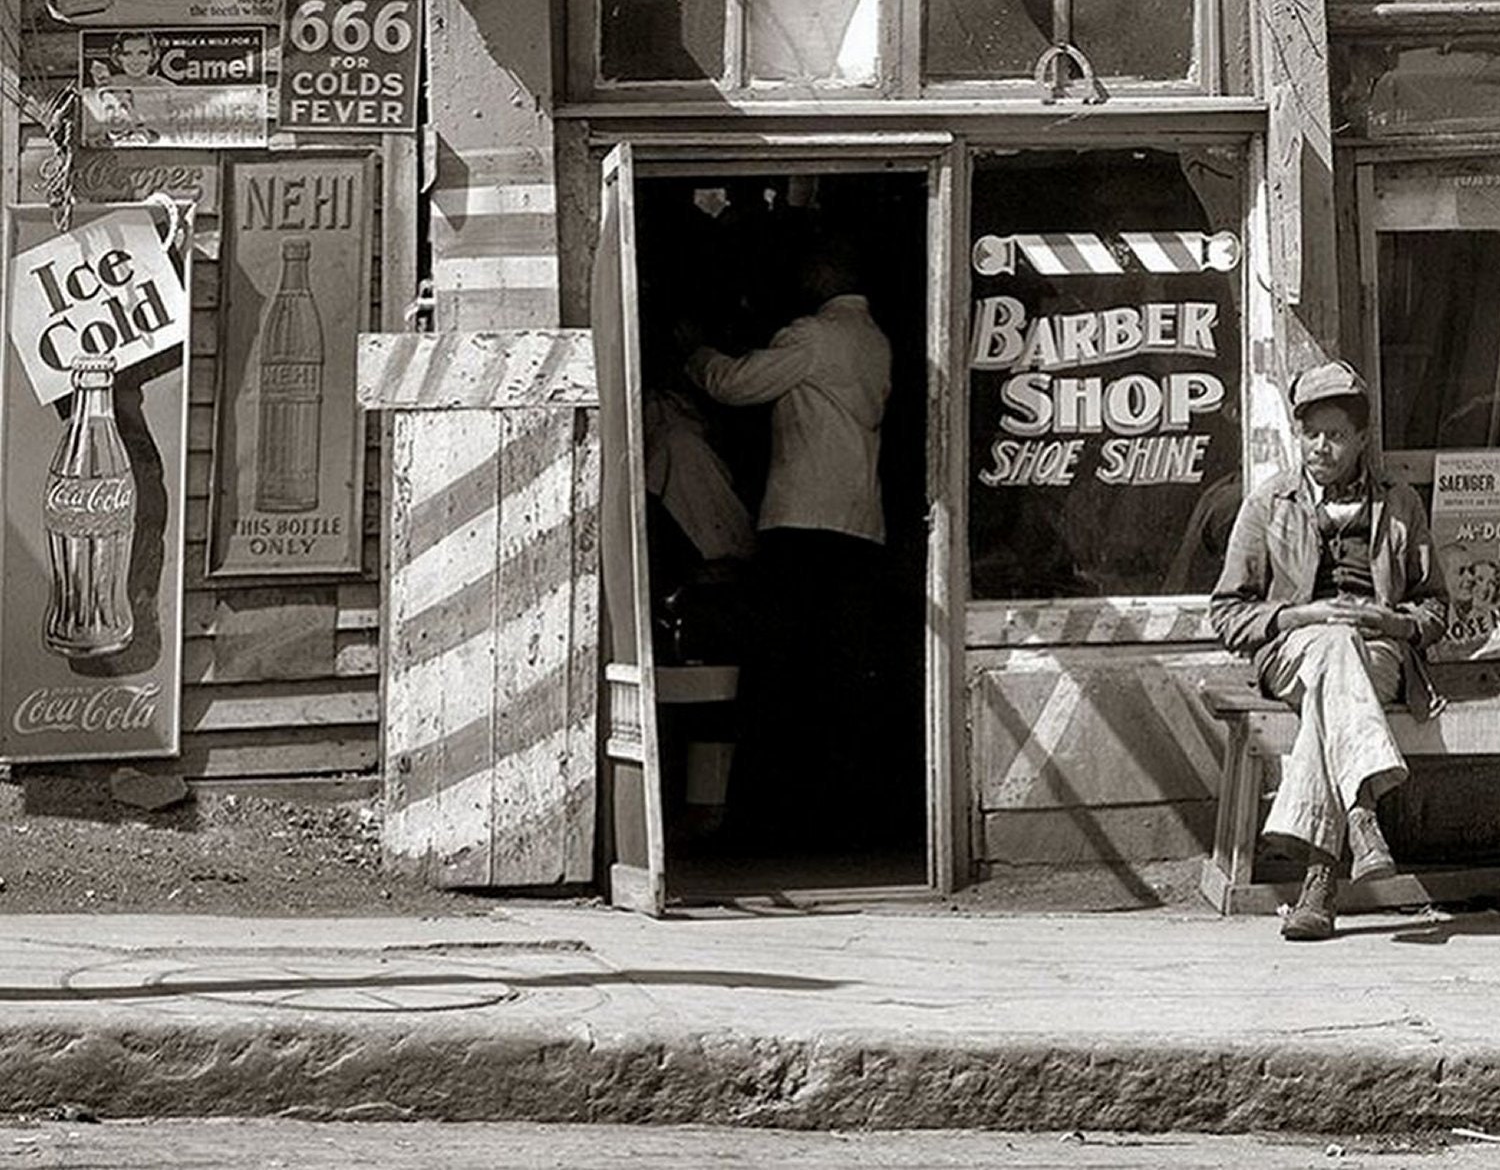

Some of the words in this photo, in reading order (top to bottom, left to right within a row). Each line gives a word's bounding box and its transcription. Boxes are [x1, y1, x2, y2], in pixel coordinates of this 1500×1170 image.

[290, 0, 413, 54] 666
[160, 49, 255, 82] Camel
[292, 72, 404, 96] COLDS
[330, 56, 371, 70] FOR
[290, 100, 403, 125] FEVER
[242, 175, 355, 230] NEHI
[30, 247, 135, 319] Ice
[38, 279, 176, 373] Cold
[969, 295, 1218, 373] BARBER
[1000, 373, 1226, 436] SHOP
[978, 439, 1085, 486] SHOE
[1096, 435, 1211, 485] SHINE
[233, 517, 271, 536] THIS
[275, 517, 341, 536] BOTTLE
[249, 537, 317, 555] ONLY
[1445, 616, 1489, 642] OSE
